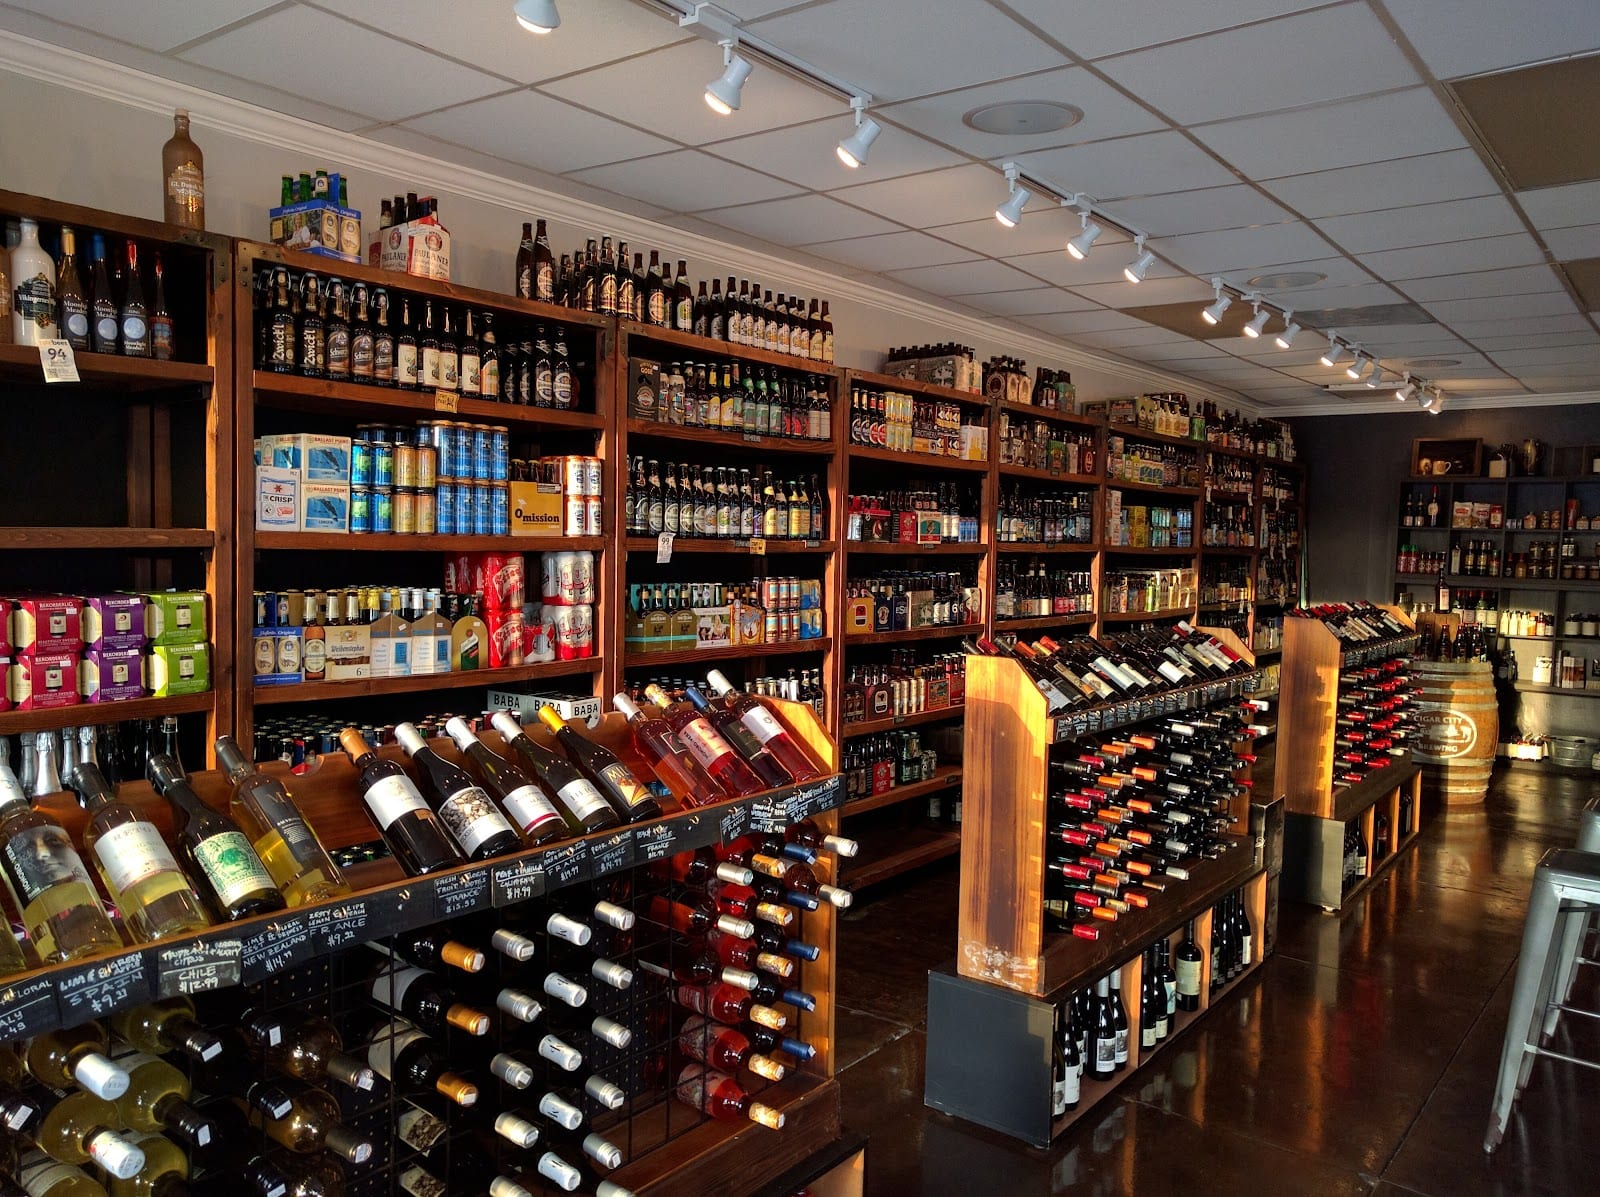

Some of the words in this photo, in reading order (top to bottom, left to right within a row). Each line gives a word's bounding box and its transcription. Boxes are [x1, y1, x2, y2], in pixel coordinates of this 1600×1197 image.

[381, 252, 407, 263] PAULANER
[414, 248, 449, 267] PAULANER
[47, 347, 67, 360] 94
[269, 495, 293, 503] CRISP
[514, 508, 560, 523] Omission
[661, 537, 670, 545] 99
[356, 667, 362, 677] 6
[494, 694, 520, 709] BABA
[574, 703, 599, 717] BABA
[1414, 715, 1440, 724] CIGAR
[1443, 717, 1463, 725] CITY
[547, 852, 587, 876] FRANCE
[310, 917, 366, 938] FRANCE
[243, 952, 266, 968] NEW
[267, 934, 307, 956] ZEALAND
[59, 968, 96, 991] LIME
[179, 965, 216, 981] CHILE
[69, 971, 143, 1007] SPAIN
[179, 976, 218, 994] $12.99
